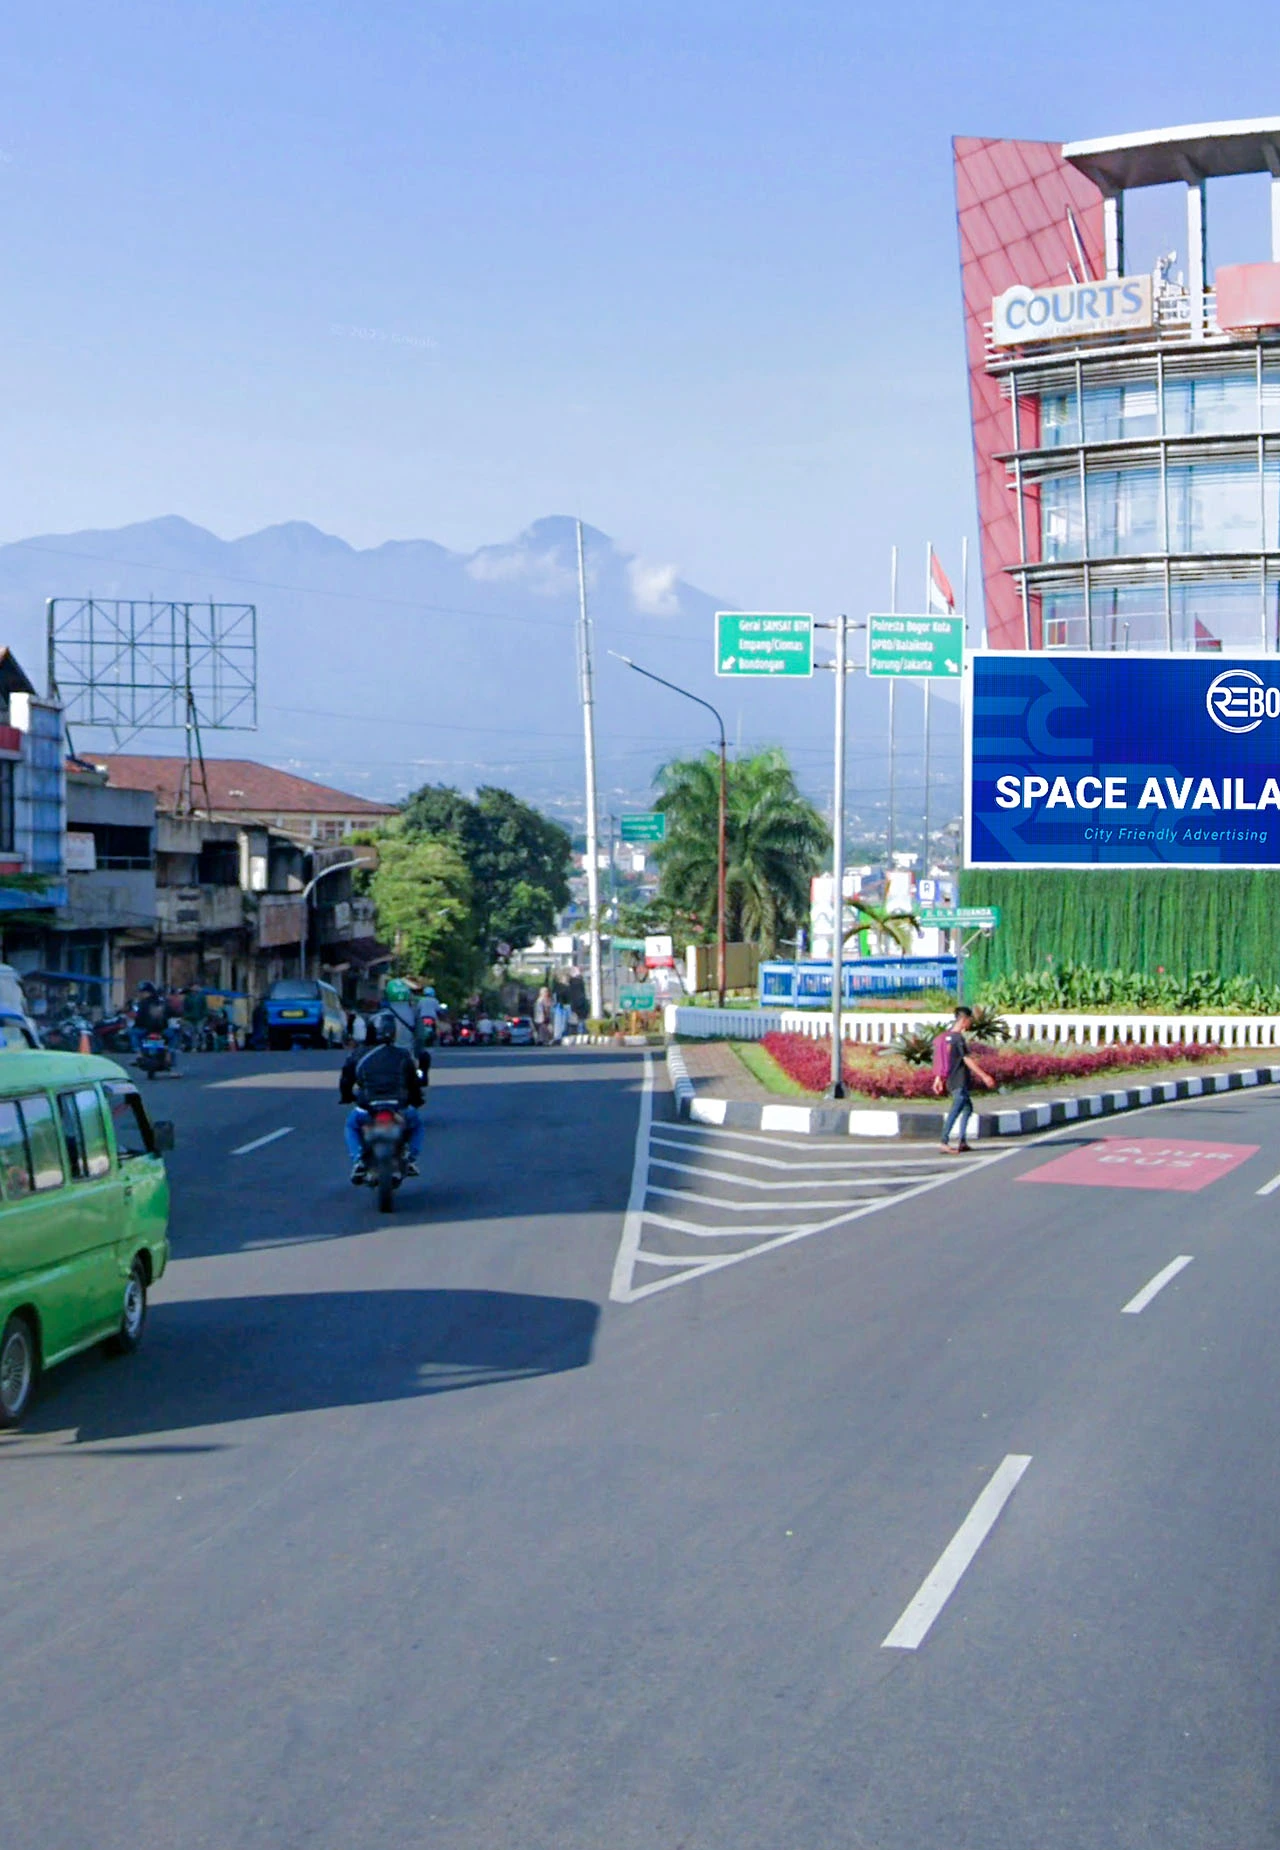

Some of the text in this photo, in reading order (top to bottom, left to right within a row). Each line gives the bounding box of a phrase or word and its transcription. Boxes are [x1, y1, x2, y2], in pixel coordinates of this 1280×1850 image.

[1006, 282, 1143, 330] COURTS
[995, 775, 1128, 810] SPACE
[1084, 827, 1268, 844] City Friendly Advertising
[1098, 1155, 1195, 1168] BUS
